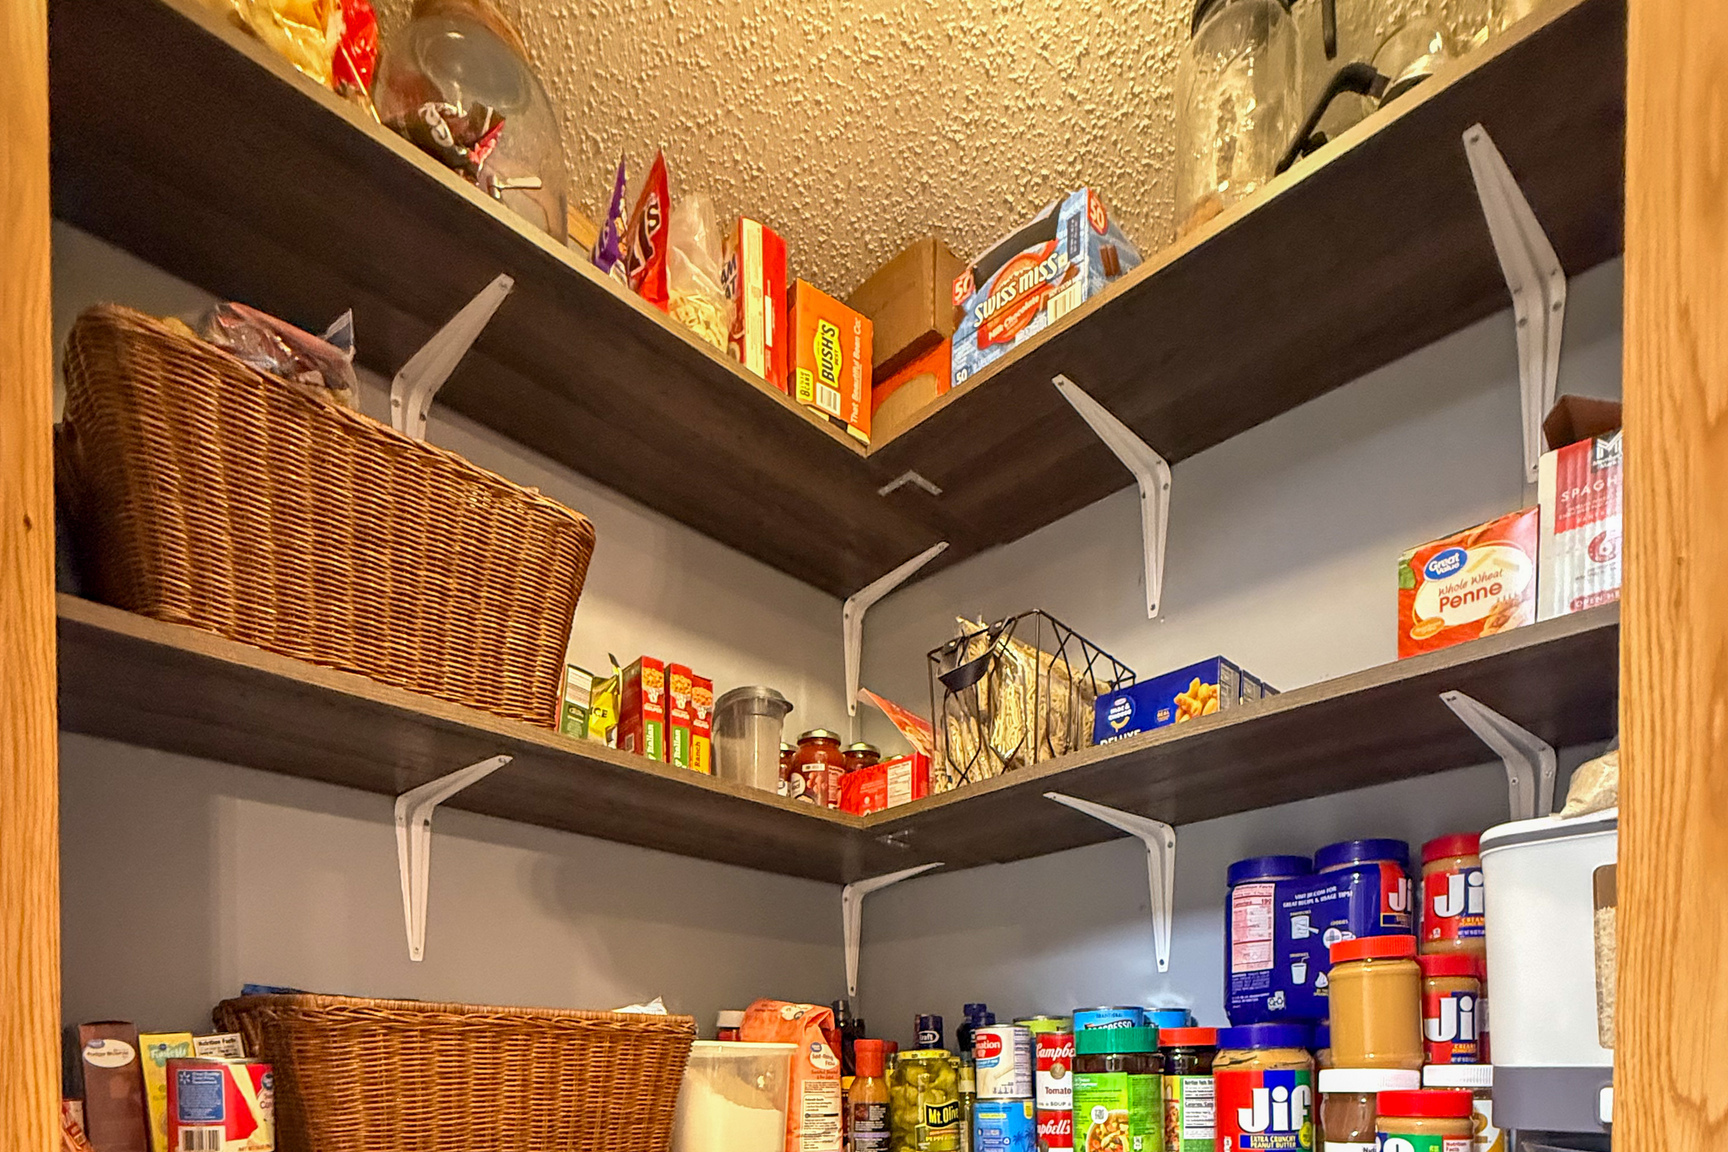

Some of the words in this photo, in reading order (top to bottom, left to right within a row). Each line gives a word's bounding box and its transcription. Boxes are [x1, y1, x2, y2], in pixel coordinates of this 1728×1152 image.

[1089, 199, 1106, 234] 50
[973, 280, 1017, 328] SWISS
[1017, 251, 1059, 293] MISS
[821, 323, 836, 384] BUSH'S
[955, 368, 968, 386] 50
[850, 402, 859, 424] That
[1561, 476, 1618, 503] SPAGH
[1428, 552, 1460, 573] Great
[1434, 562, 1461, 576] Value
[1438, 579, 1468, 597] Whole
[1471, 568, 1503, 587] Wheat
[1438, 582, 1503, 613] Penne
[1606, 590, 1621, 602] HE
[589, 705, 608, 719] ICE
[1433, 869, 1484, 919] Ji
[976, 1041, 1001, 1051] nation
[1036, 1042, 1076, 1062] Campbe
[1044, 1086, 1072, 1095] Tomato
[928, 1107, 943, 1125] Mt.
[1237, 1084, 1312, 1133] Jif
[1036, 1119, 1071, 1136] mpbell's
[1250, 1135, 1269, 1143] EXTRA
[1269, 1135, 1296, 1143] CRUNCHY
[1250, 1141, 1275, 1149] PEANUT
[1275, 1141, 1297, 1149] BUTTER
